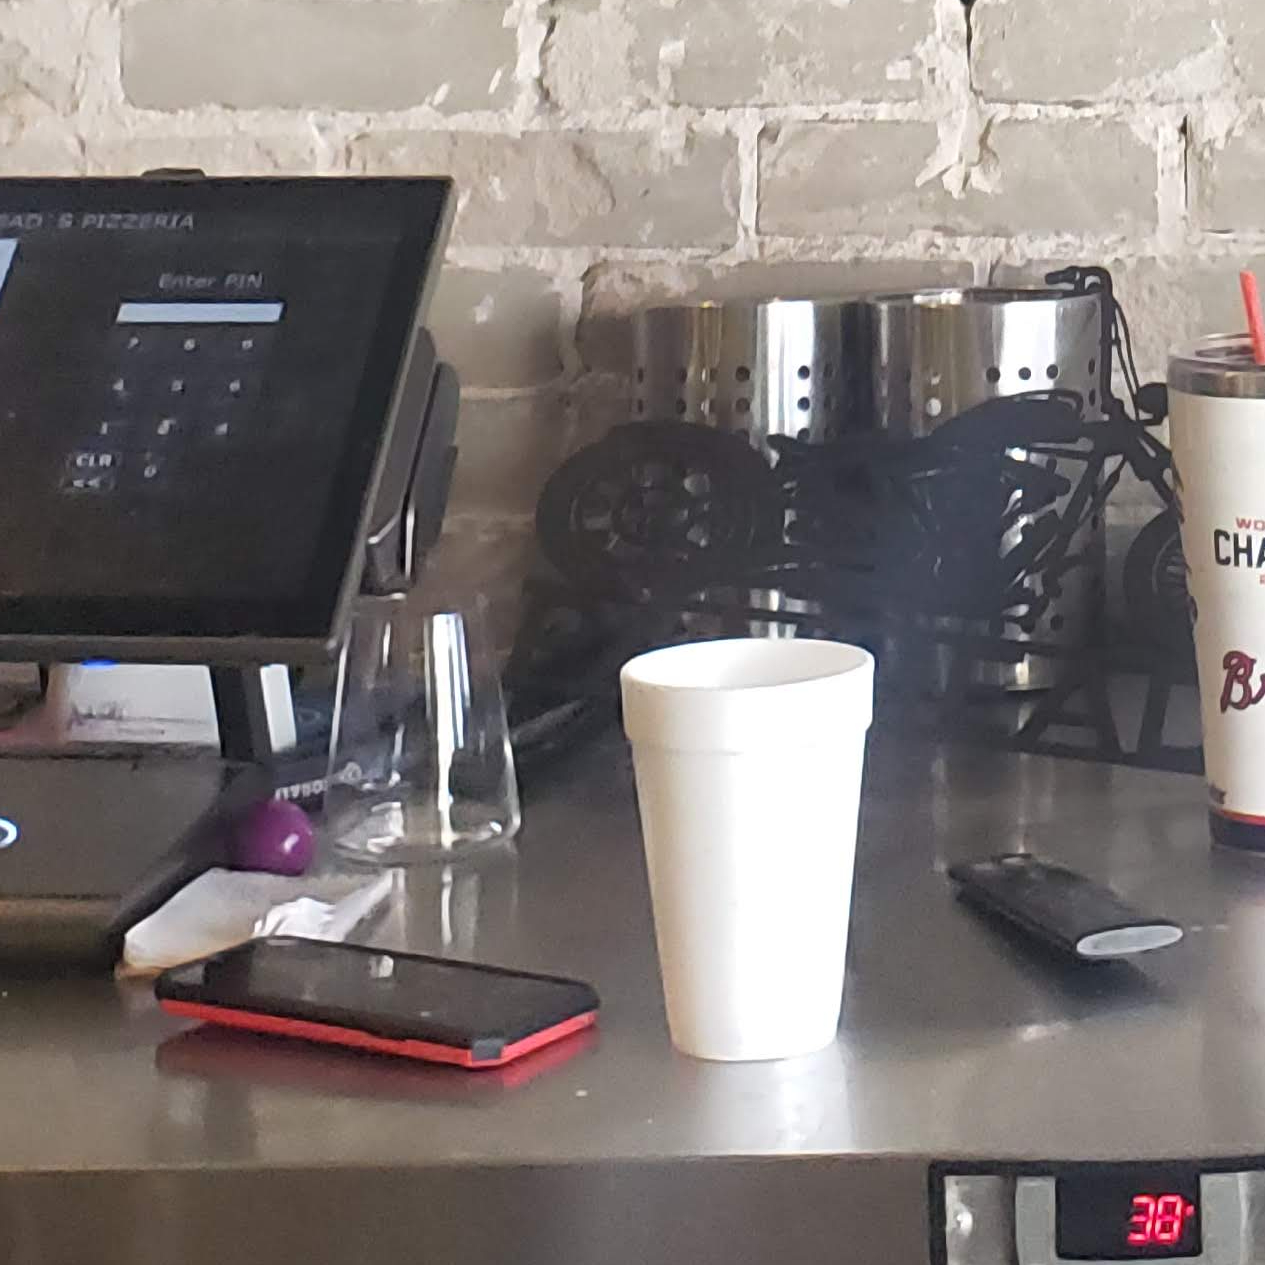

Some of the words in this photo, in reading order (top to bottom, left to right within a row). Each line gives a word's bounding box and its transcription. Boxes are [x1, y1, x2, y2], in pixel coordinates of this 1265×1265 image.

[81, 213, 194, 229] PIZZERIA
[159, 273, 217, 289] Enter
[224, 272, 263, 288] PIN
